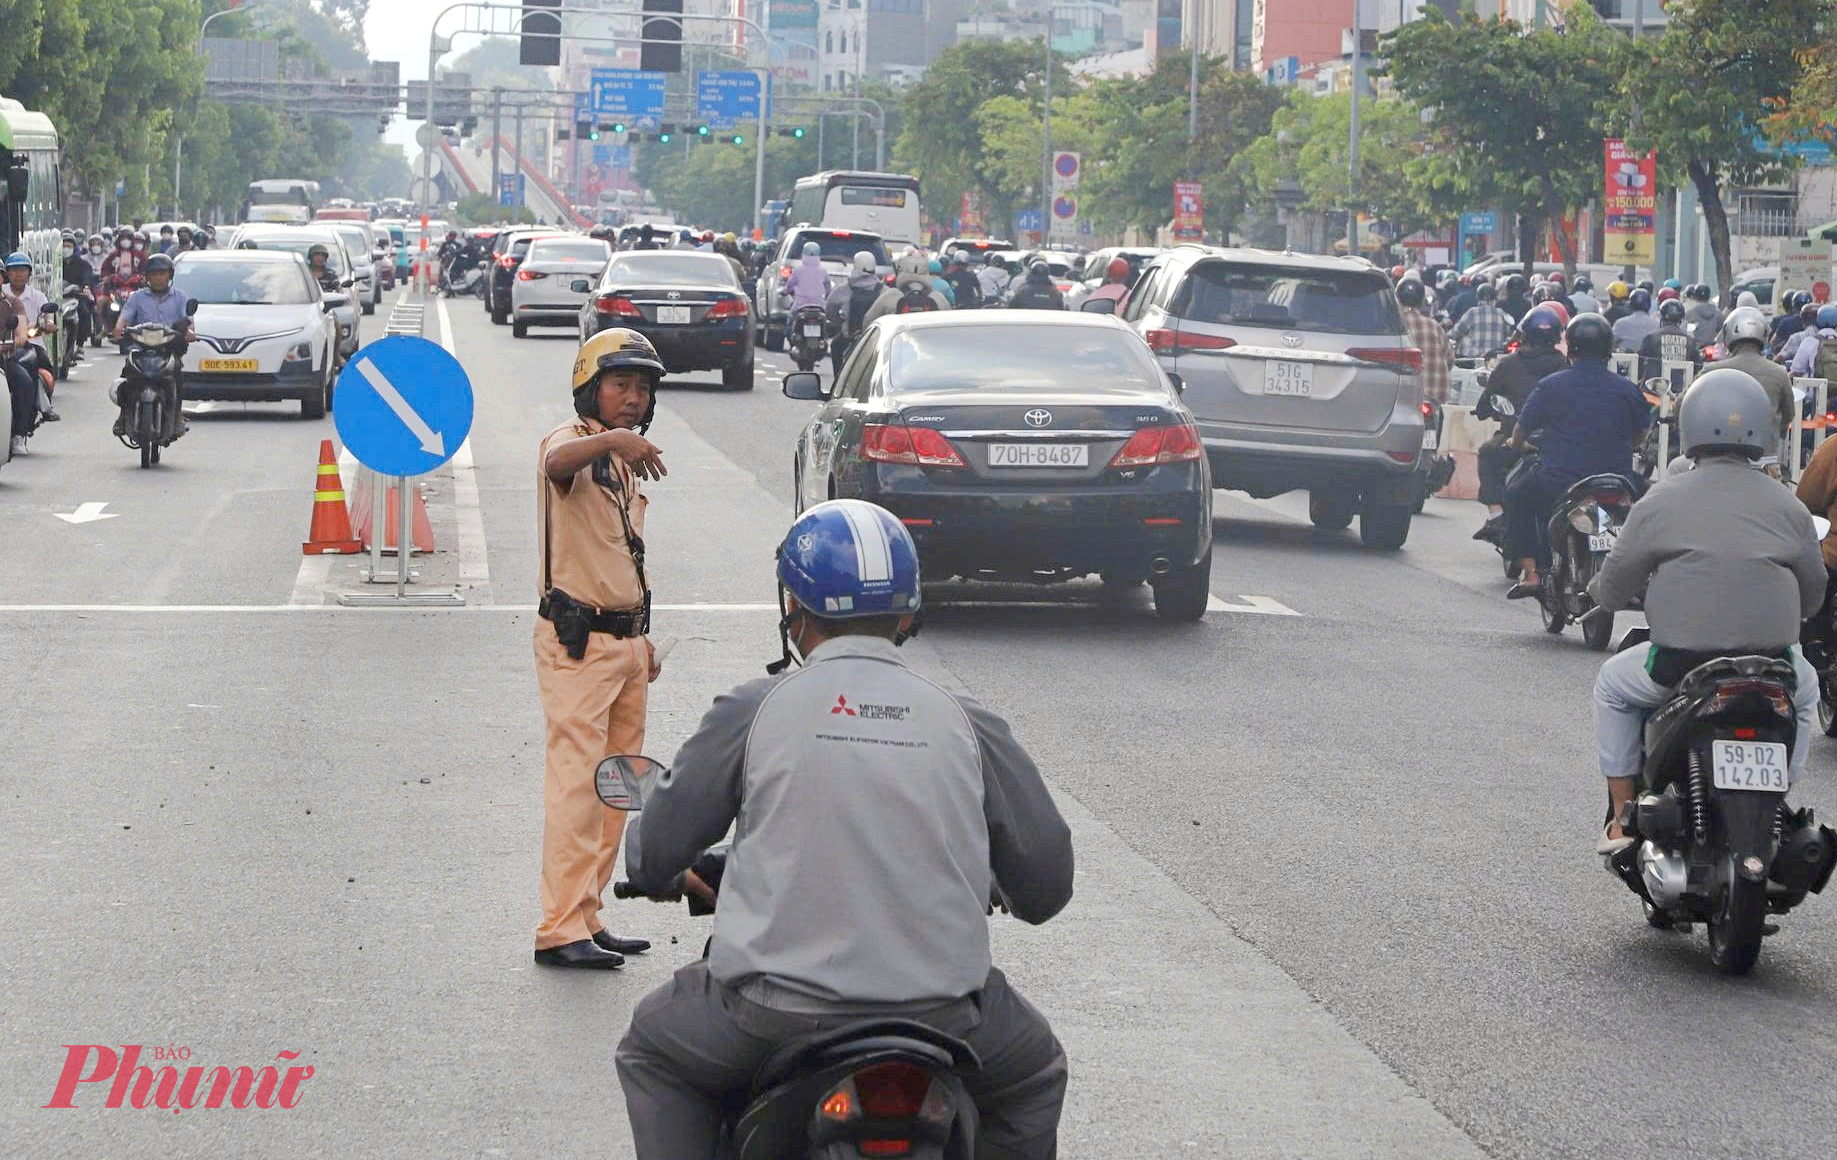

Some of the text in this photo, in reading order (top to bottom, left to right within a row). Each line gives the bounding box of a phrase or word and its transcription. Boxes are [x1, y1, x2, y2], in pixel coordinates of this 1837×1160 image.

[1277, 362, 1302, 379] 51G
[995, 446, 1082, 464] 70H-8487
[863, 580, 892, 588] HONDA
[859, 703, 910, 714] MITSUBISHI
[860, 712, 905, 721] ELECTRIC
[1724, 745, 1775, 766] 59-D2
[1719, 766, 1783, 787] 142.03
